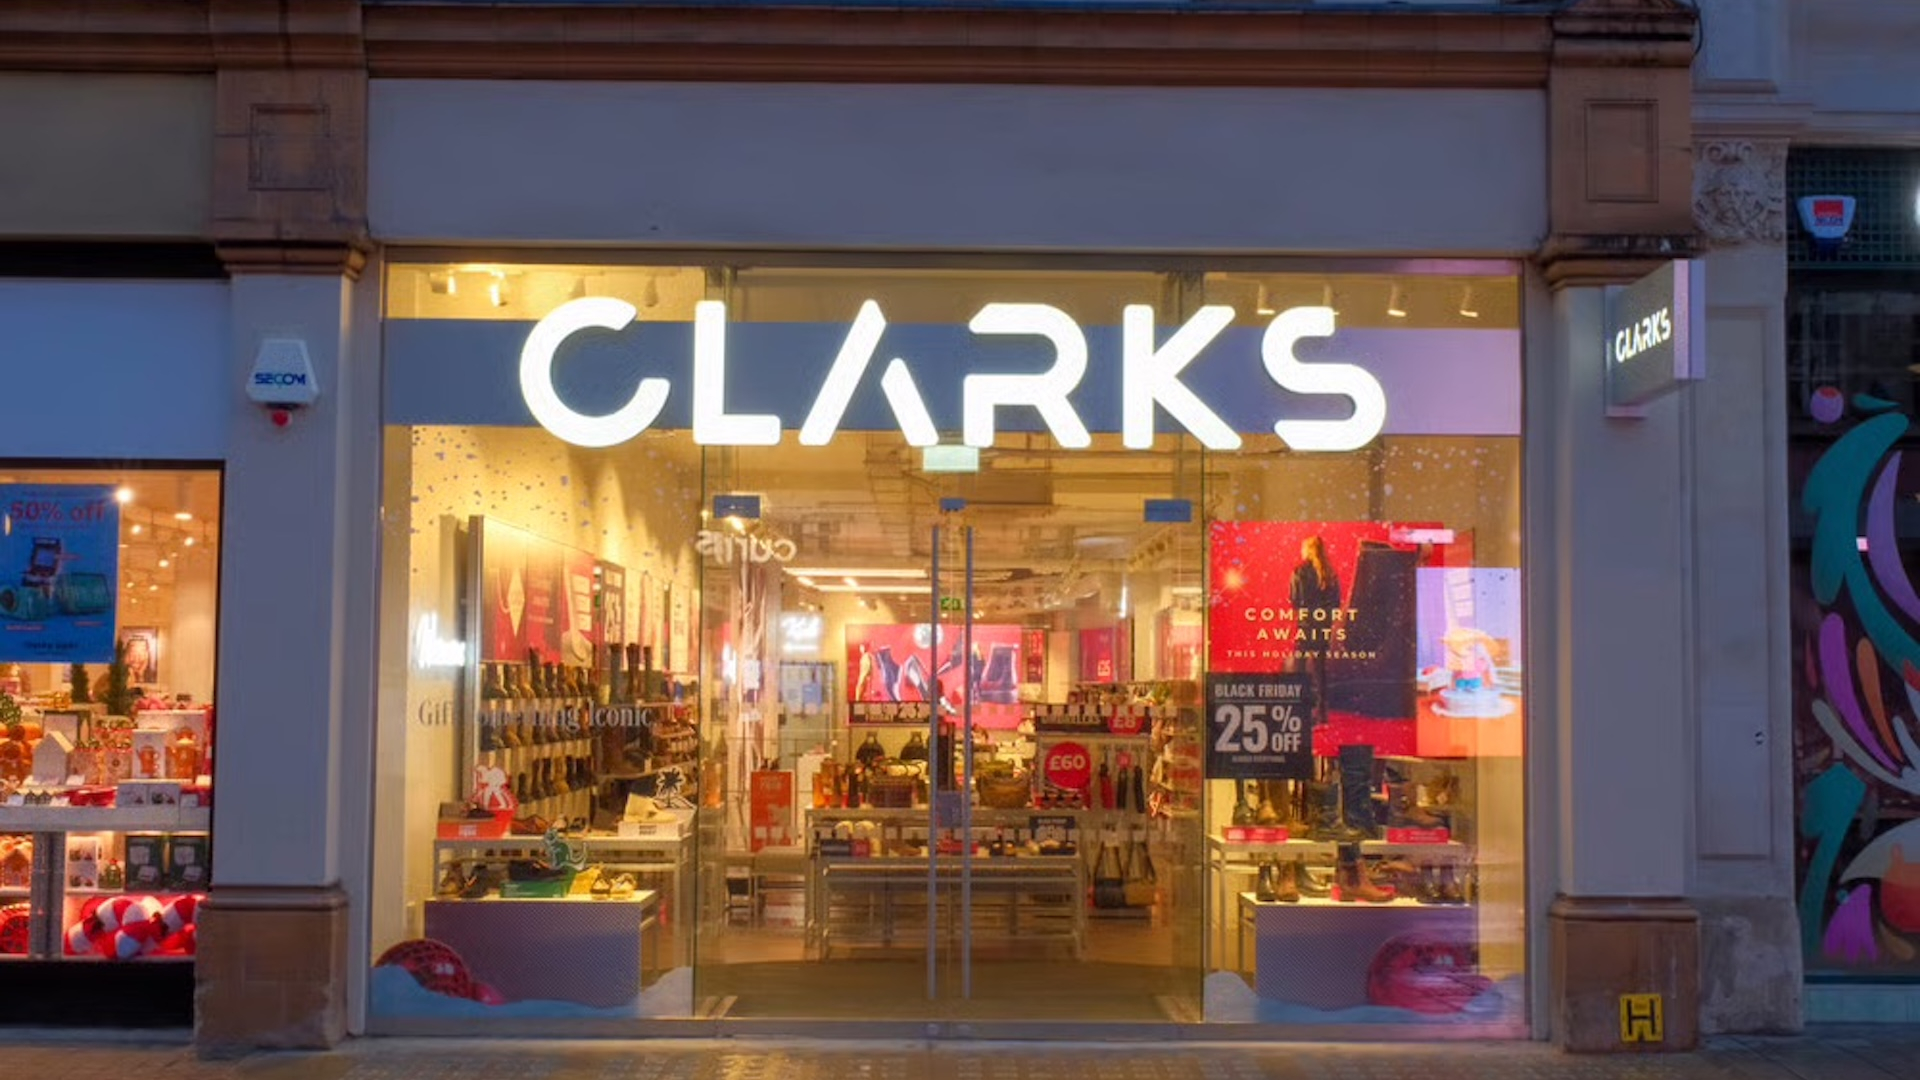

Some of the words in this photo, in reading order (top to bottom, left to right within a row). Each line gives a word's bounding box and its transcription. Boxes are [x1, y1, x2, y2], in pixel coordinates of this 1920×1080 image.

[1615, 307, 1672, 363] CLARKS
[254, 373, 307, 387] SECOM
[520, 298, 1386, 452] CLARKS
[1244, 608, 1358, 621] COMFORT
[1256, 628, 1347, 641] AWAITS
[1227, 650, 1256, 658] THIS
[1326, 651, 1376, 659] SEASON
[1214, 684, 1255, 698] BLACK
[1258, 685, 1302, 698] FRIDAY
[589, 697, 653, 727] Iconic
[1271, 733, 1301, 751] OFF
[1049, 755, 1086, 770] £60
[1626, 998, 1656, 1037] H
